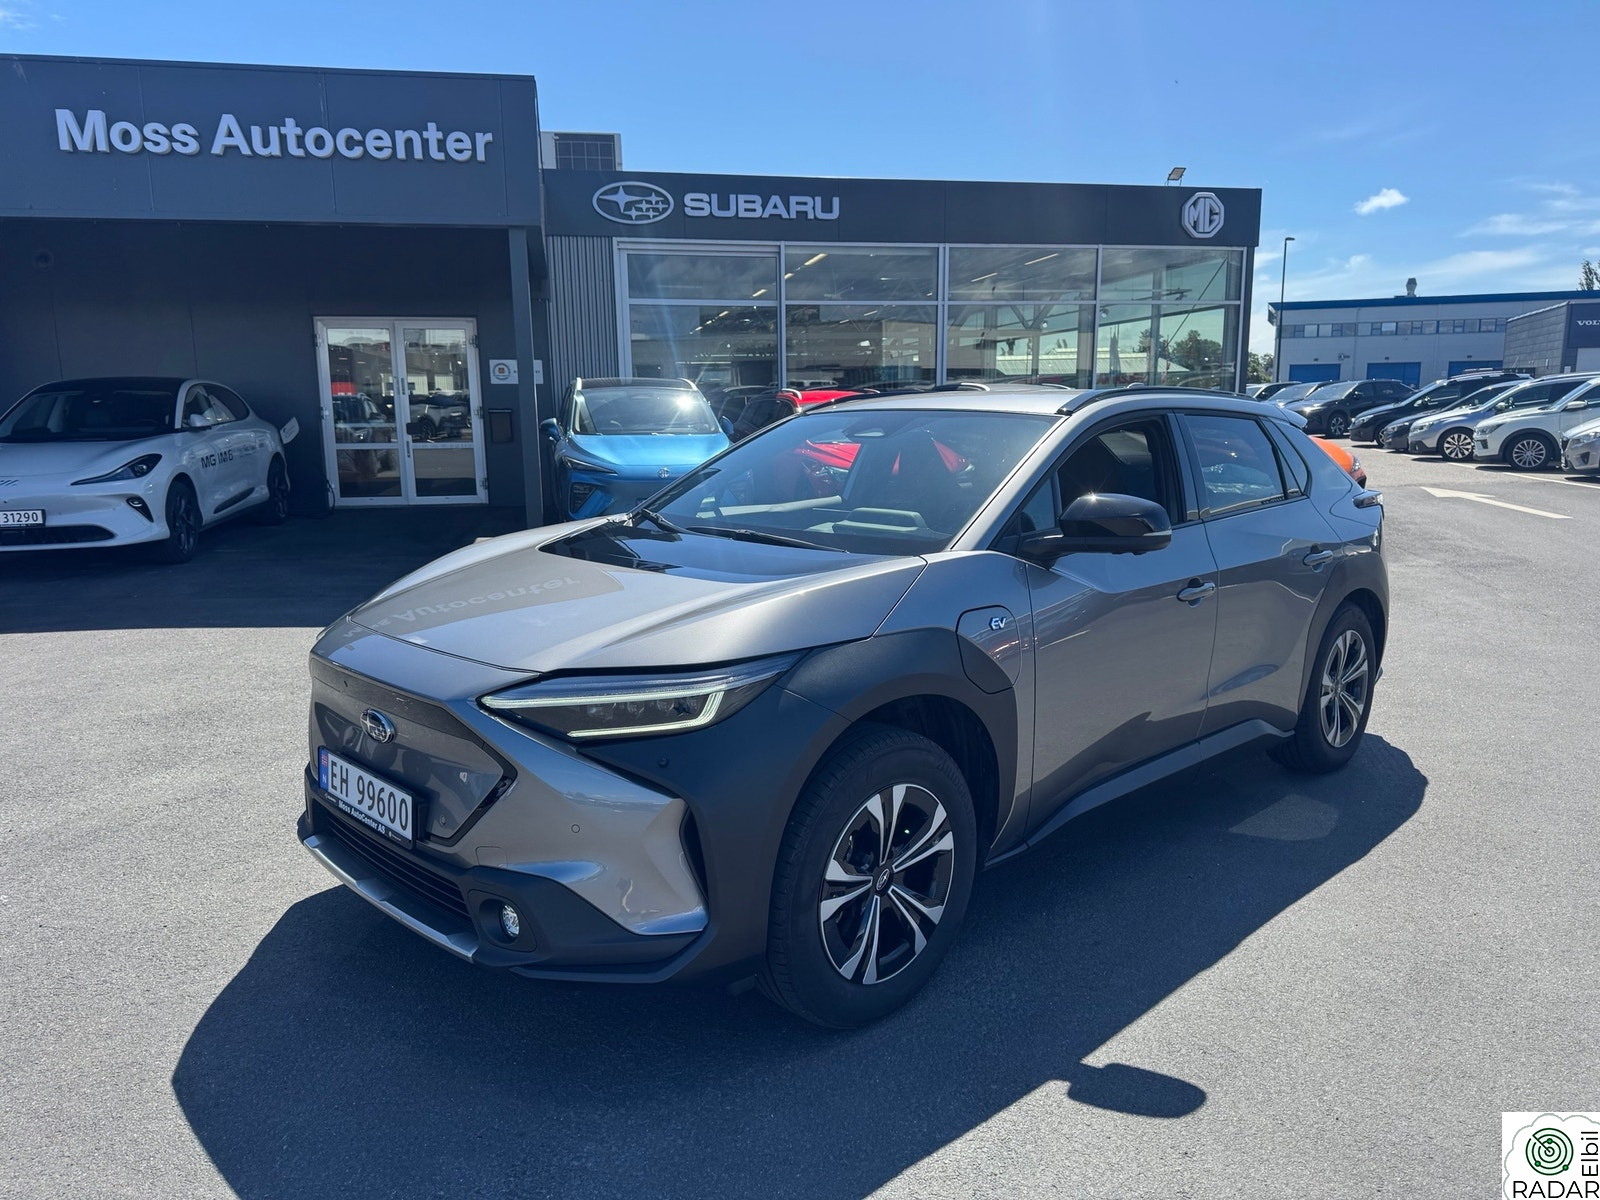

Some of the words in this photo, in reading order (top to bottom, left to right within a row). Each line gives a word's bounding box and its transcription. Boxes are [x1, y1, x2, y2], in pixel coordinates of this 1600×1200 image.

[55, 108, 200, 155] Moss
[211, 113, 494, 163] Autocenter
[684, 192, 839, 219] SUBARU
[1188, 197, 1220, 232] MG
[200, 454, 217, 469] MG
[217, 449, 234, 465] IM6
[2, 511, 38, 523] 31290
[991, 617, 1006, 630] EV
[331, 760, 348, 798] EH
[356, 774, 408, 831] 99600
